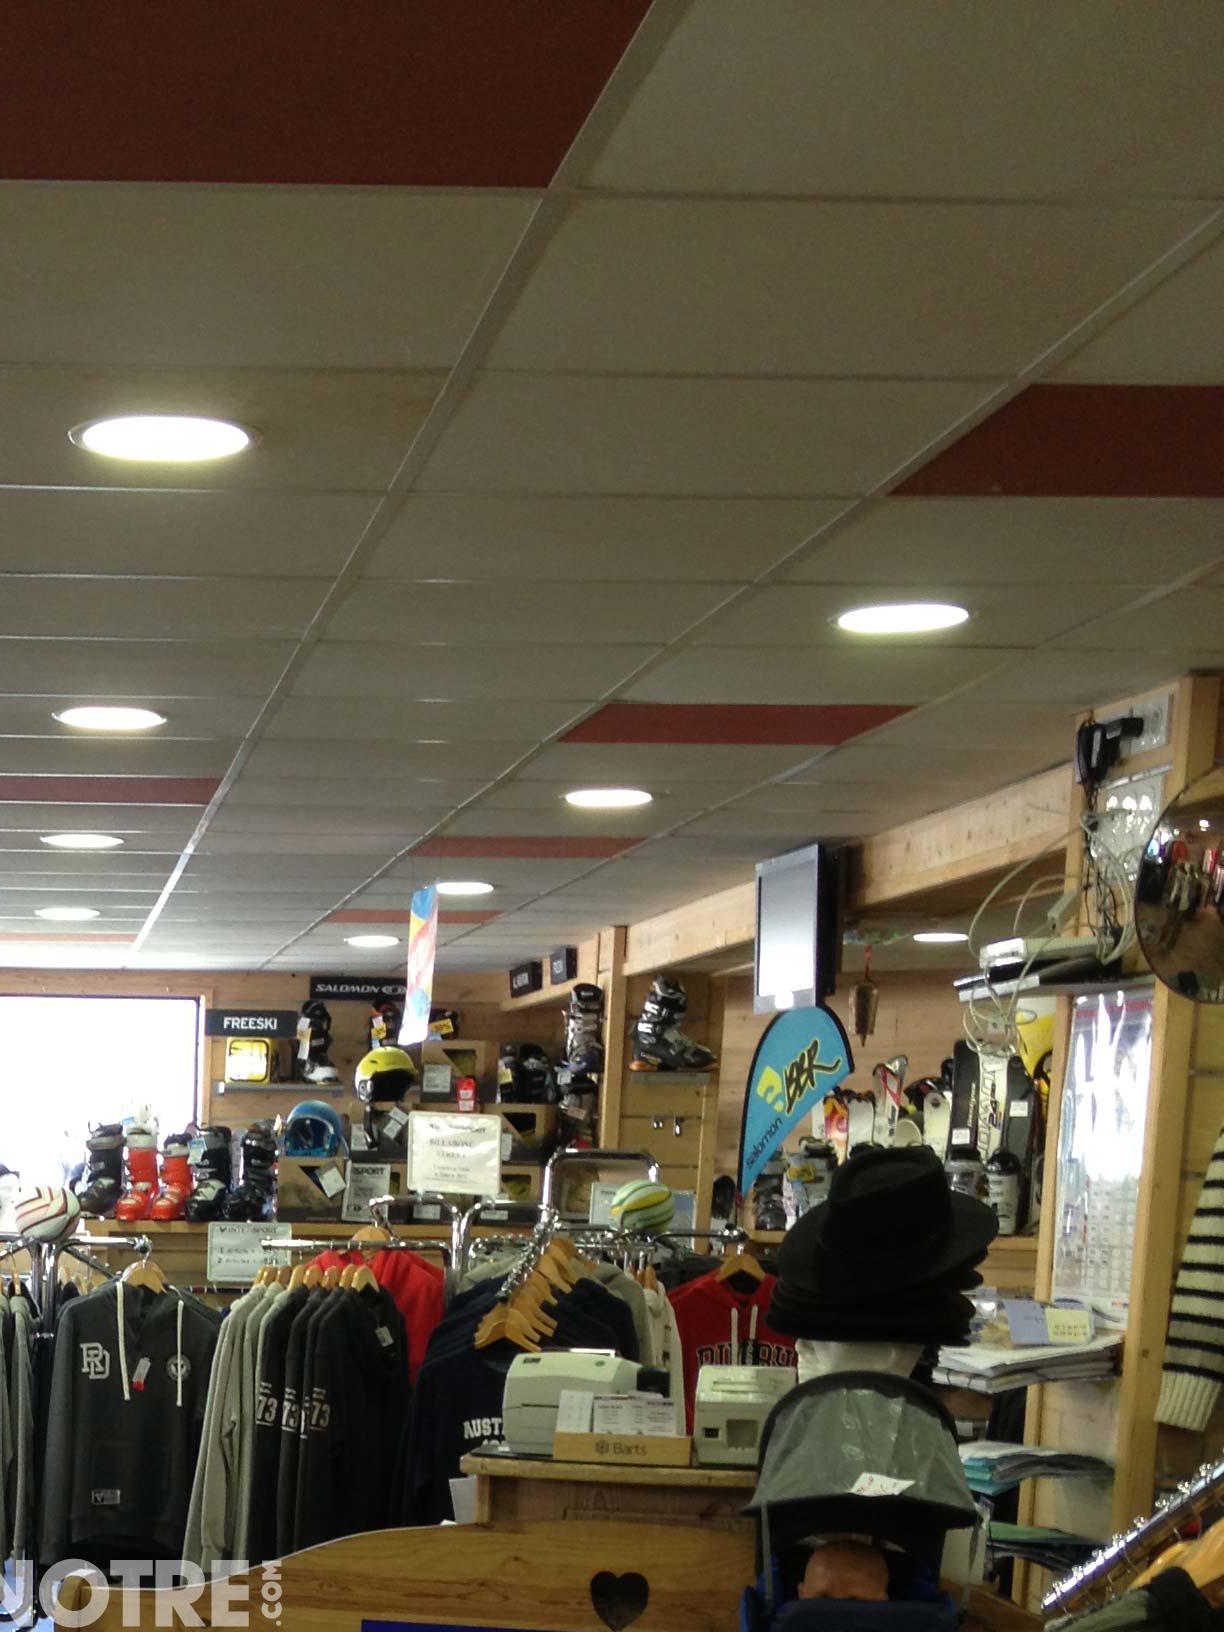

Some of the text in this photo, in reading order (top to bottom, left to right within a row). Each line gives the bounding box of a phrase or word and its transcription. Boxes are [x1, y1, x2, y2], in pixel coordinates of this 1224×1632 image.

[314, 983, 380, 994] SALOMON
[223, 1016, 278, 1030] FREESKI
[746, 1117, 783, 1170] salomon
[255, 1396, 277, 1422] 73
[281, 1401, 301, 1428] 73
[310, 1401, 331, 1428] 73
[463, 1417, 505, 1440] AUST
[612, 1442, 648, 1456] Barts
